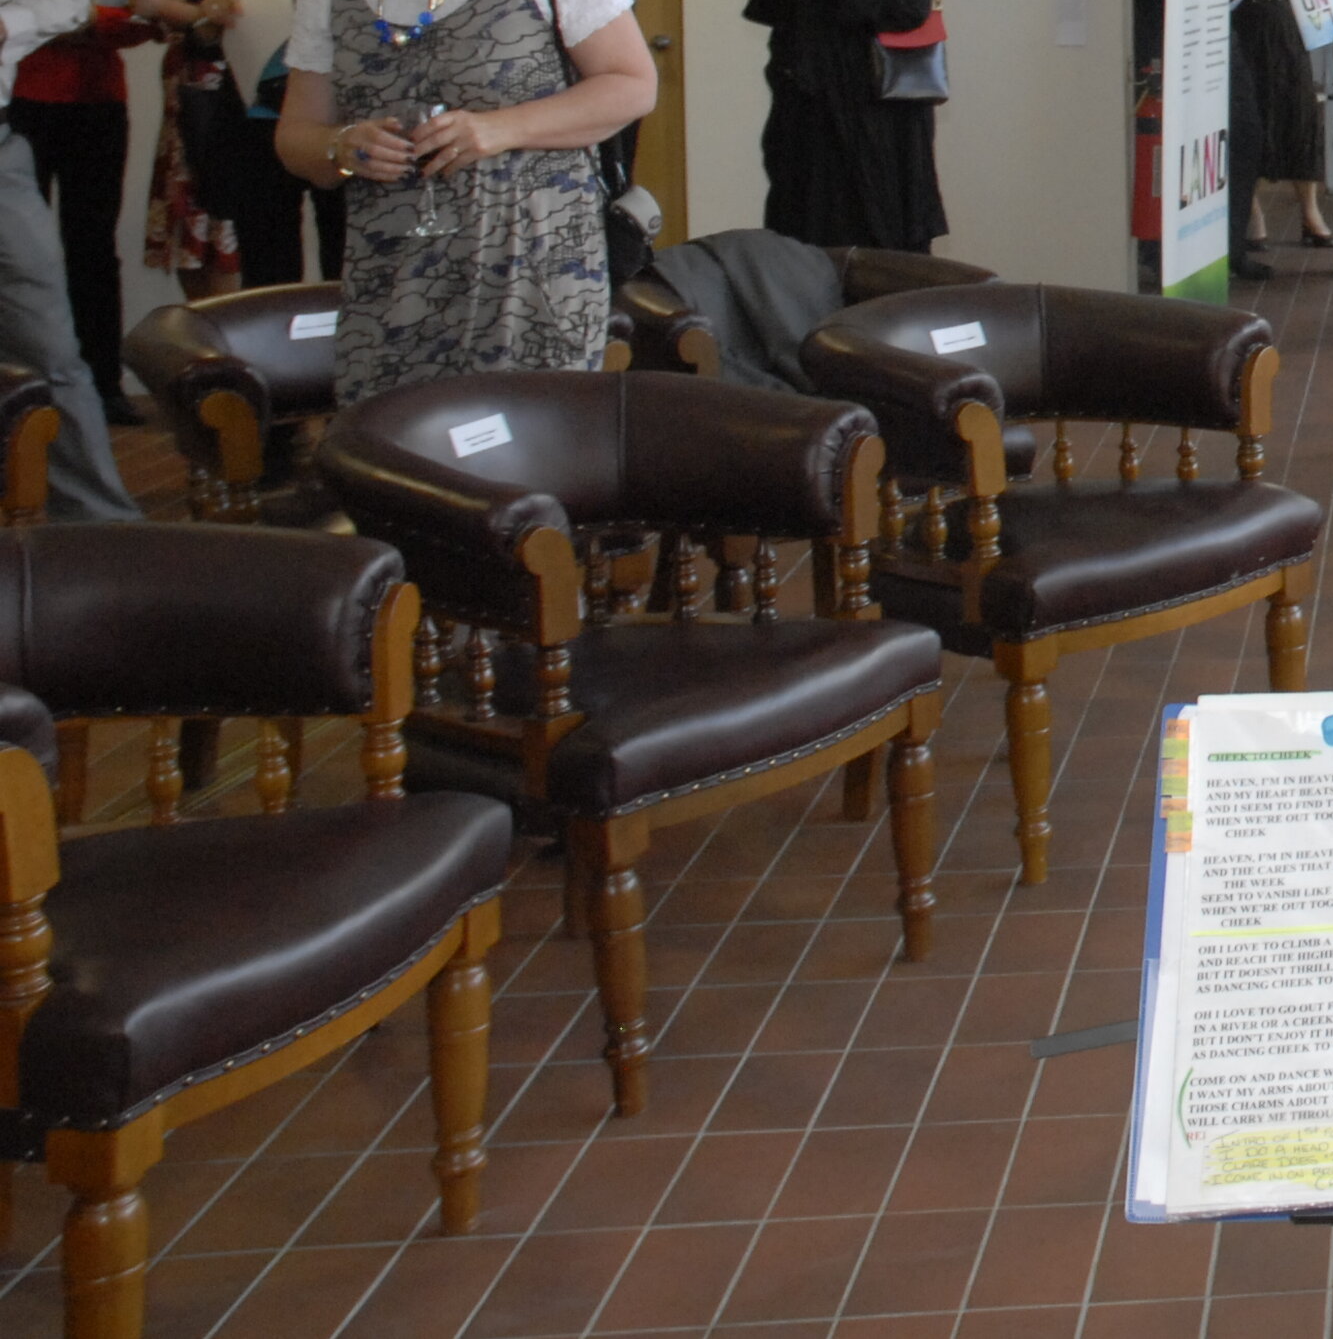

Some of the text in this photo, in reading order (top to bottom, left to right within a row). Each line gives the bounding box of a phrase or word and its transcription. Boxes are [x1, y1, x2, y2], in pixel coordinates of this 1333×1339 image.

[1179, 129, 1229, 210] LAND
[1208, 750, 1312, 762] CHEEK TO CHEEK
[1282, 775, 1296, 785] IN
[1205, 803, 1231, 814] AND
[1240, 801, 1273, 812] SEEM
[1275, 800, 1292, 811] TO
[1294, 798, 1323, 809] FIND
[1206, 815, 1242, 827] WHEN
[1284, 812, 1310, 822] OUT
[1225, 827, 1266, 838] CHEEK
[1279, 850, 1292, 860] IN
[1223, 877, 1285, 888] THE WEEK
[1221, 917, 1261, 927] CHEEK
[1198, 944, 1216, 955] OH
[1226, 941, 1259, 953] LOVE
[1261, 940, 1279, 951] TO
[1281, 937, 1321, 949] CLIMB
[1198, 957, 1223, 968] AND
[1225, 954, 1267, 966] REACH
[1269, 952, 1294, 963] THE
[1197, 970, 1220, 981] BUT
[1222, 969, 1235, 979] IT
[1237, 965, 1286, 978] DOESNT
[1288, 962, 1333, 974] THRILL
[1196, 984, 1211, 994] AS
[1213, 980, 1269, 993] DANCING
[1271, 976, 1313, 988] CHEEK
[1315, 975, 1333, 985] TO
[1194, 1010, 1212, 1020] OH
[1222, 1007, 1256, 1018] LOVE
[1258, 1005, 1275, 1016] TO
[1277, 1004, 1296, 1014] GO
[1298, 1002, 1324, 1013] OUT
[1193, 1023, 1206, 1033] IN
[1220, 1020, 1258, 1032] RIVER
[1260, 1018, 1278, 1029] OR
[1291, 1014, 1333, 1026] CREEK
[1193, 1035, 1216, 1046] BUT
[1266, 1029, 1307, 1041] ENJOY
[1309, 1028, 1322, 1038] IT
[1192, 1050, 1206, 1060] AS
[1208, 1046, 1265, 1059] DANCING
[1267, 1042, 1310, 1054] CHEEK
[1312, 1041, 1330, 1051] TO
[1190, 1075, 1226, 1086] COME
[1228, 1073, 1247, 1084] ON
[1249, 1071, 1276, 1082] AND
[1277, 1068, 1320, 1080] DANCE
[1196, 1088, 1233, 1100] WANT
[1235, 1086, 1256, 1097] MY
[1258, 1084, 1294, 1096] ARMS
[1188, 1102, 1228, 1114] THOSE
[1230, 1098, 1284, 1111] CHARMS
[1286, 1095, 1329, 1107] ABOUT
[1187, 1116, 1219, 1128] WILL
[1221, 1113, 1265, 1125] CARRY
[1267, 1111, 1288, 1122] ME
